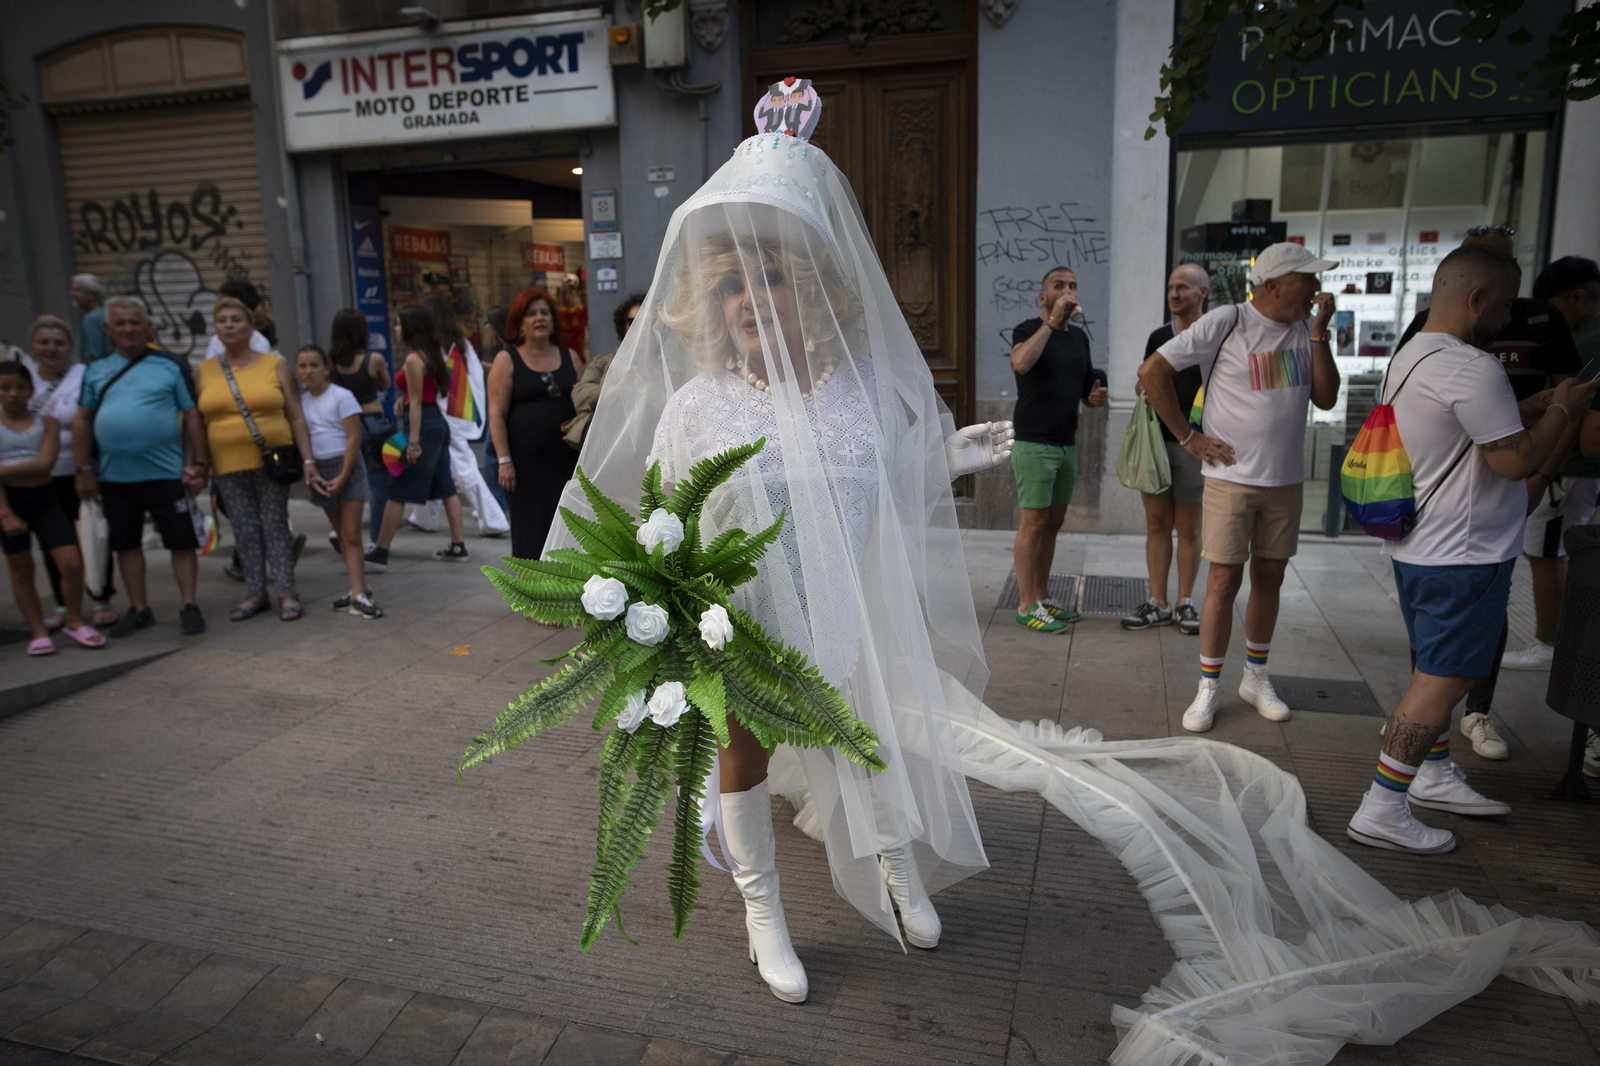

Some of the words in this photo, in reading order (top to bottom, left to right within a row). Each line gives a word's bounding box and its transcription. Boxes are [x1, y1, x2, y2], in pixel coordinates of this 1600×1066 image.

[340, 32, 584, 95] INTERSPORT
[355, 96, 415, 118] MOTO
[429, 85, 529, 111] DEPORTE
[1232, 63, 1499, 115] OPTICIANS
[403, 112, 480, 130] GRANADA
[979, 202, 1105, 238] FREE
[393, 233, 449, 255] REBAJAS
[1177, 250, 1238, 263] Pharmacy
